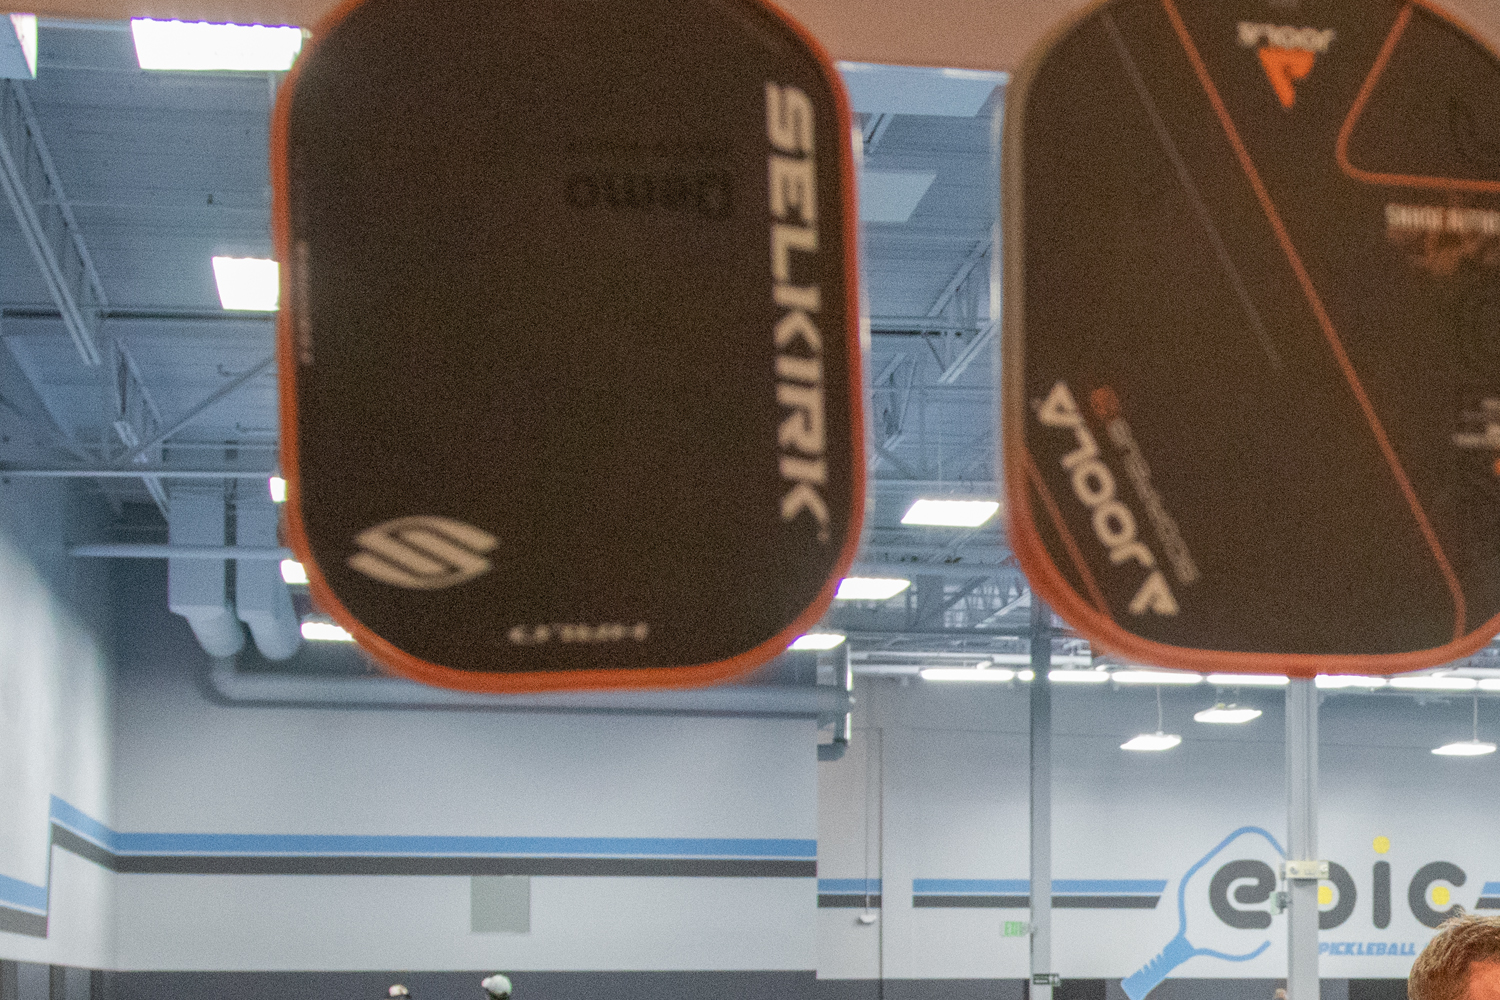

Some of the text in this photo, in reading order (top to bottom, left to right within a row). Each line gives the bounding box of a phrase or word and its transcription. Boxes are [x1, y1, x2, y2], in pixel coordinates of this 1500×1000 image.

[1237, 22, 1335, 52] JOOLA
[766, 83, 829, 528] SELKIRK
[1036, 381, 1155, 568] JOOLA
[1318, 942, 1416, 956] PICKLEBALL
